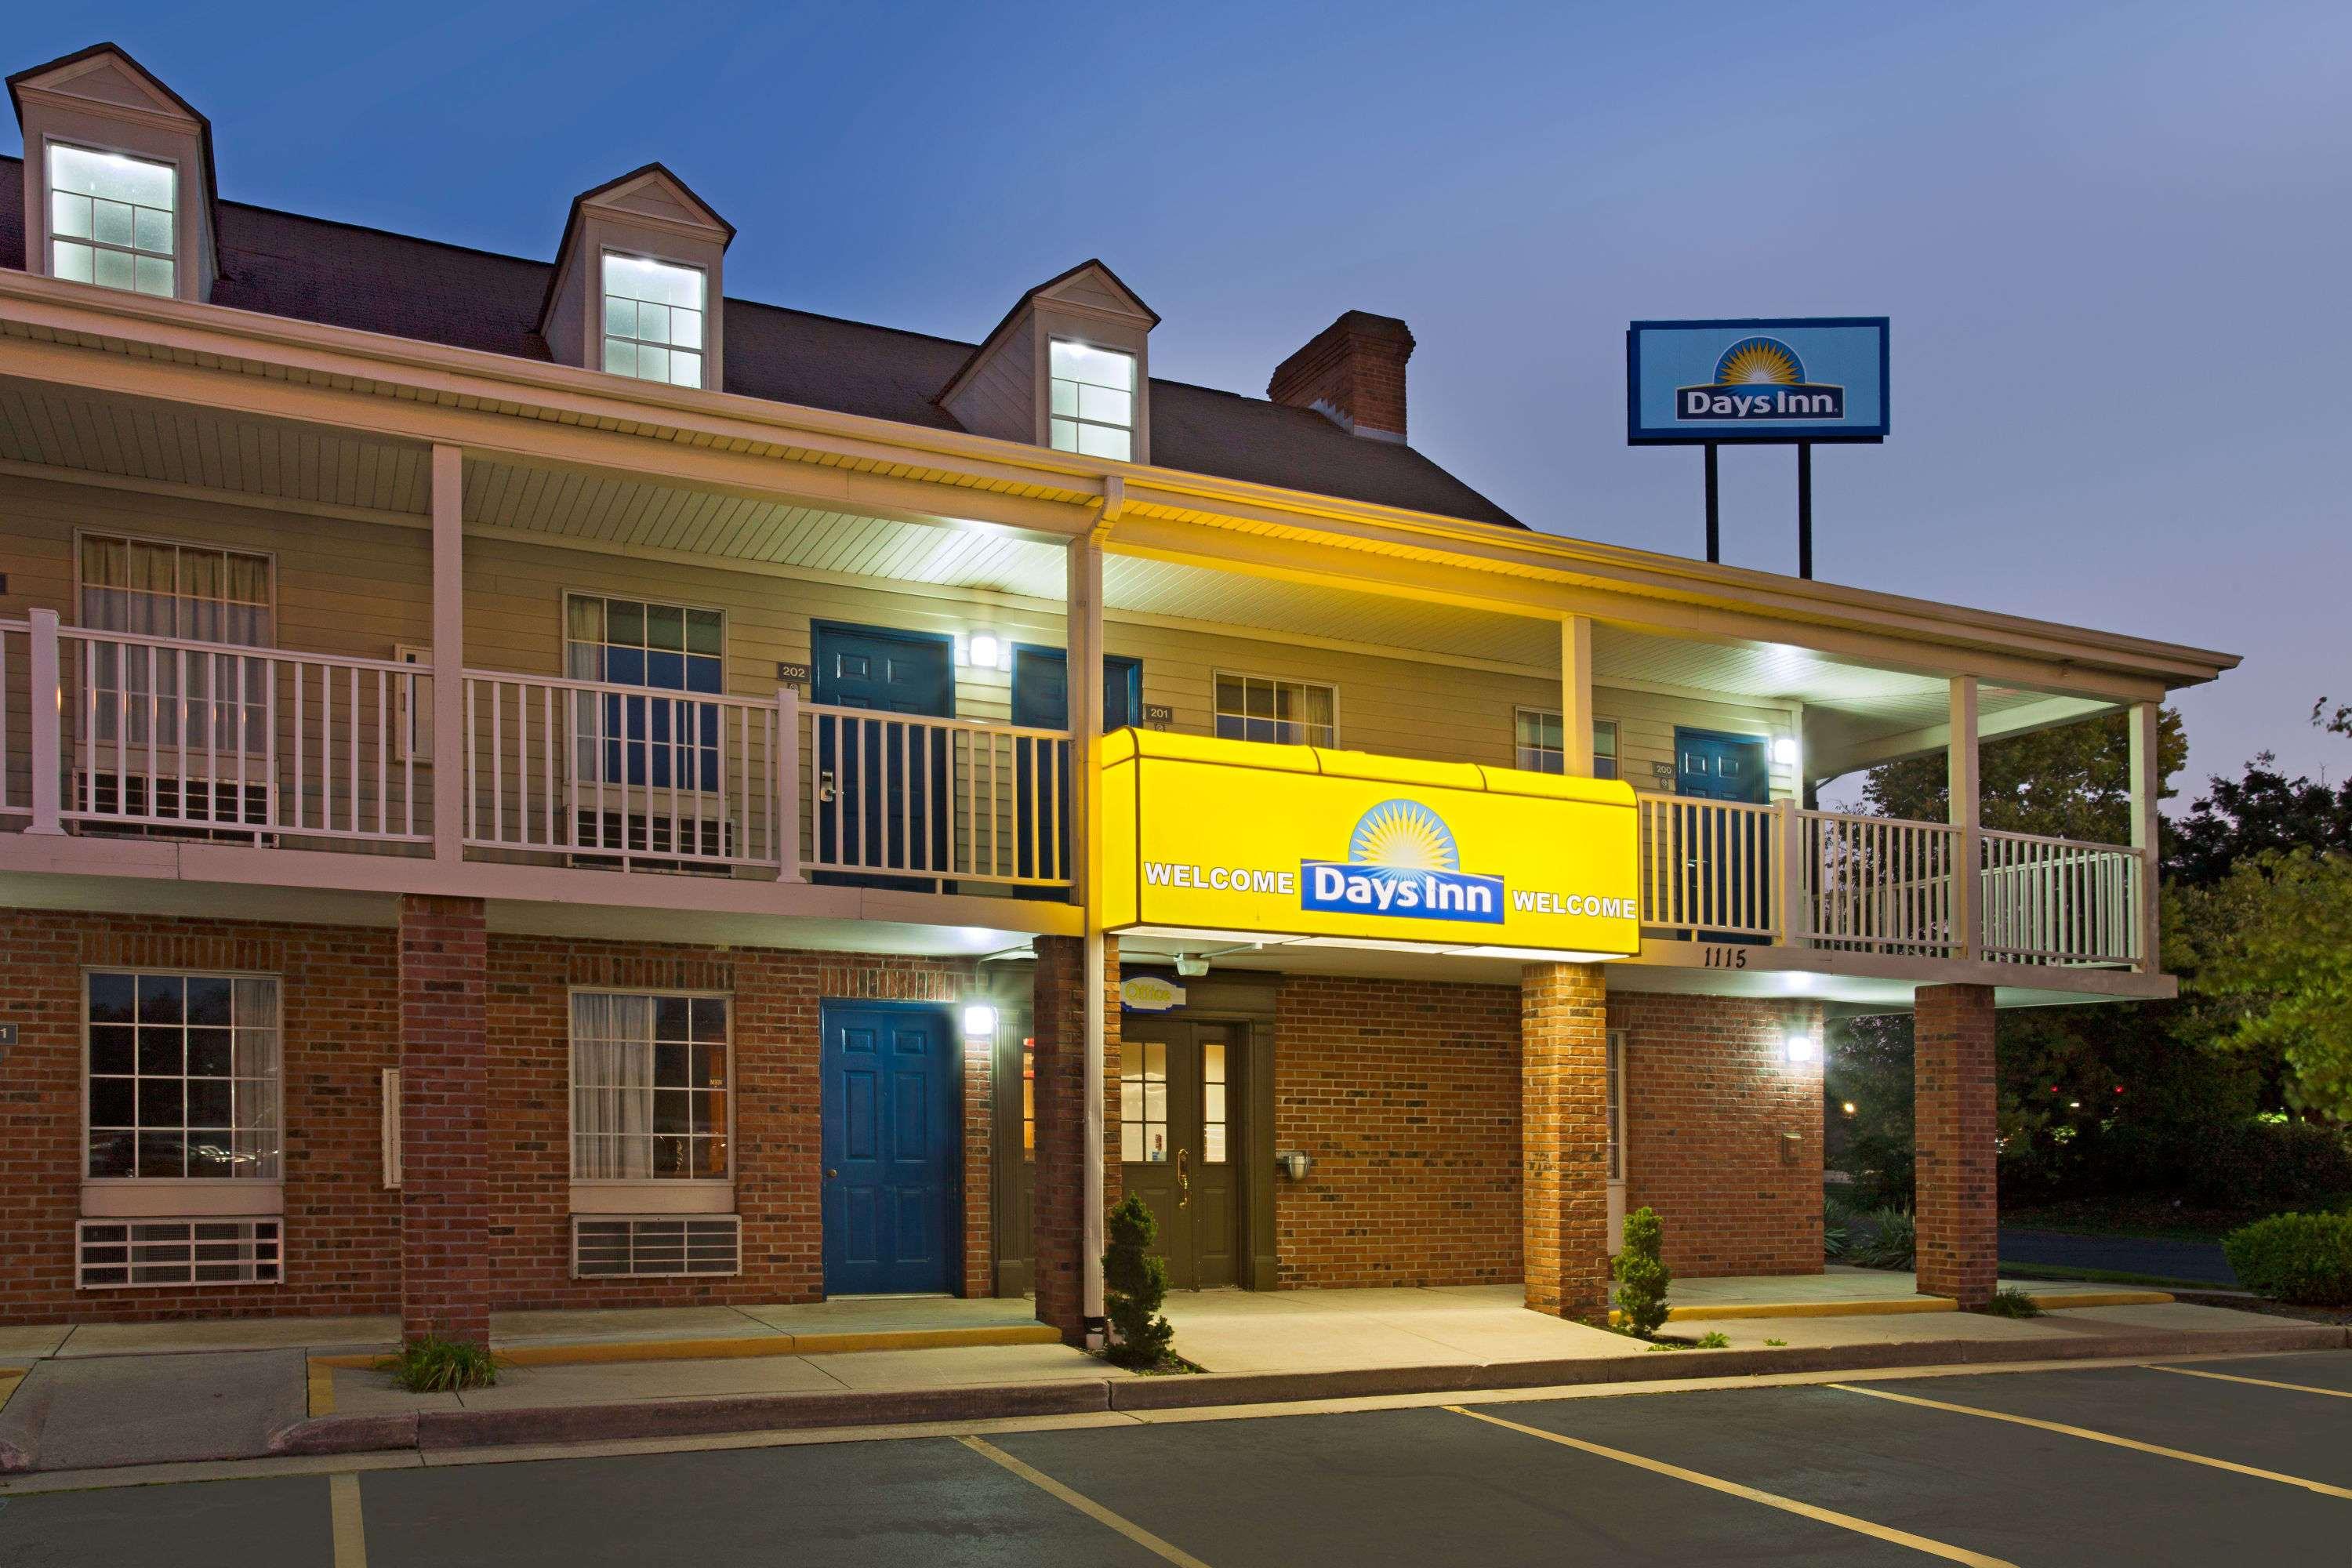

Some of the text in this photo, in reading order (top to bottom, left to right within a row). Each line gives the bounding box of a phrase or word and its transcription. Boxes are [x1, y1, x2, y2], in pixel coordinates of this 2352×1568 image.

[1687, 390, 1833, 417] Days Inn
[782, 666, 805, 677] 202
[1151, 708, 1167, 718] 201
[1657, 765, 1671, 775] 200
[1144, 862, 1294, 895] WELCOME
[1315, 866, 1493, 913] Days Inn
[1513, 890, 1637, 920] WELCOME
[1704, 947, 1747, 969] 1115
[1125, 982, 1171, 1001] Office
